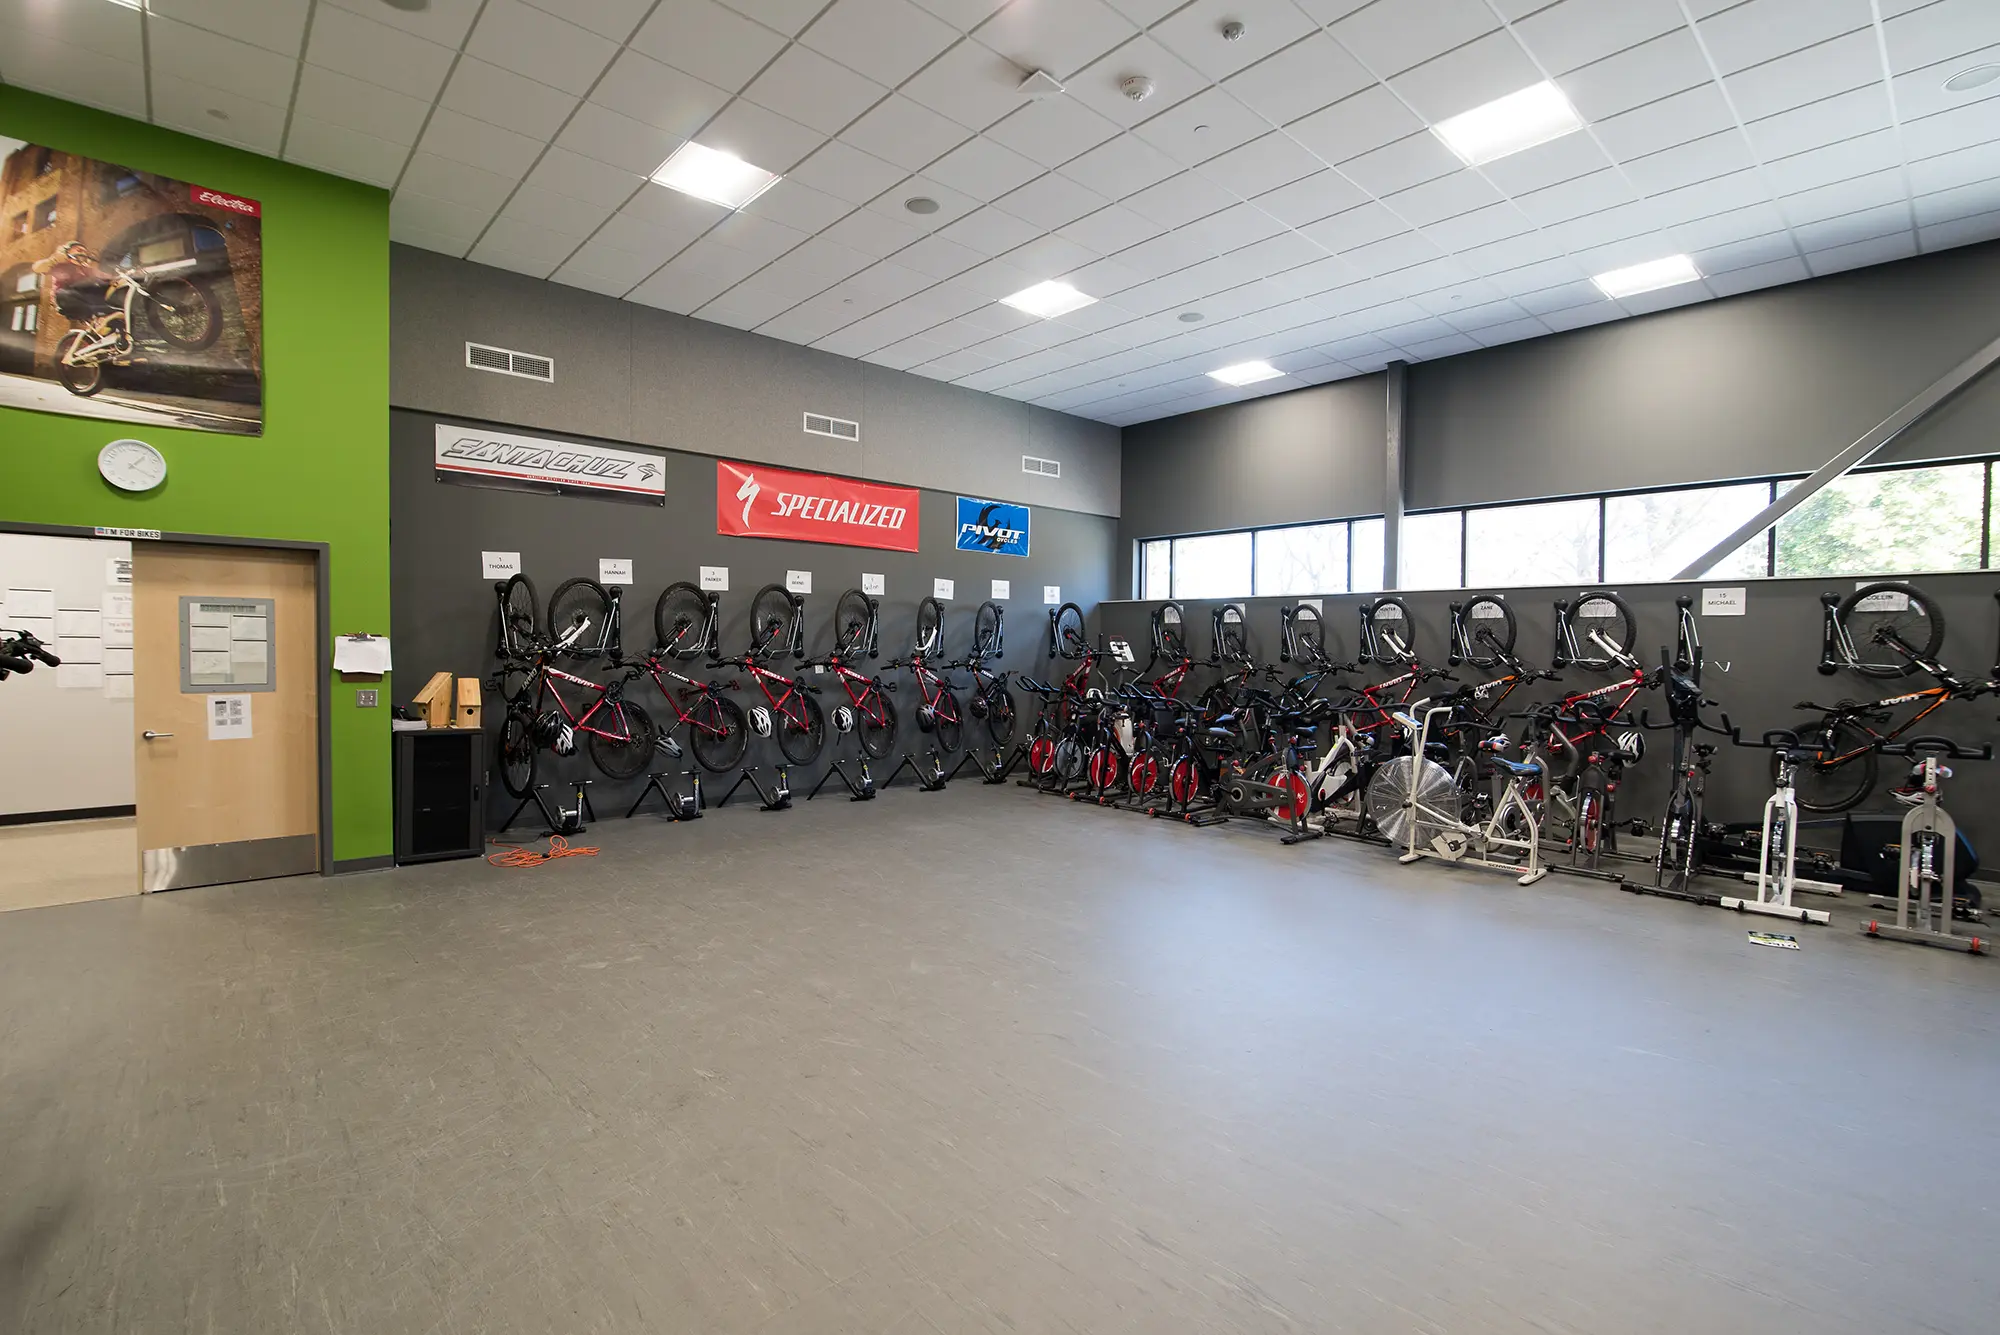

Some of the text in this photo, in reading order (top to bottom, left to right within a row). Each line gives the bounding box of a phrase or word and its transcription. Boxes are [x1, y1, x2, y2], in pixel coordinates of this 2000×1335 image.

[199, 191, 254, 213] Electra
[770, 492, 907, 530] SPECIALIZED
[137, 530, 160, 538] BIKES
[962, 523, 1025, 539] PIVOT
[564, 672, 595, 688] GIANT
